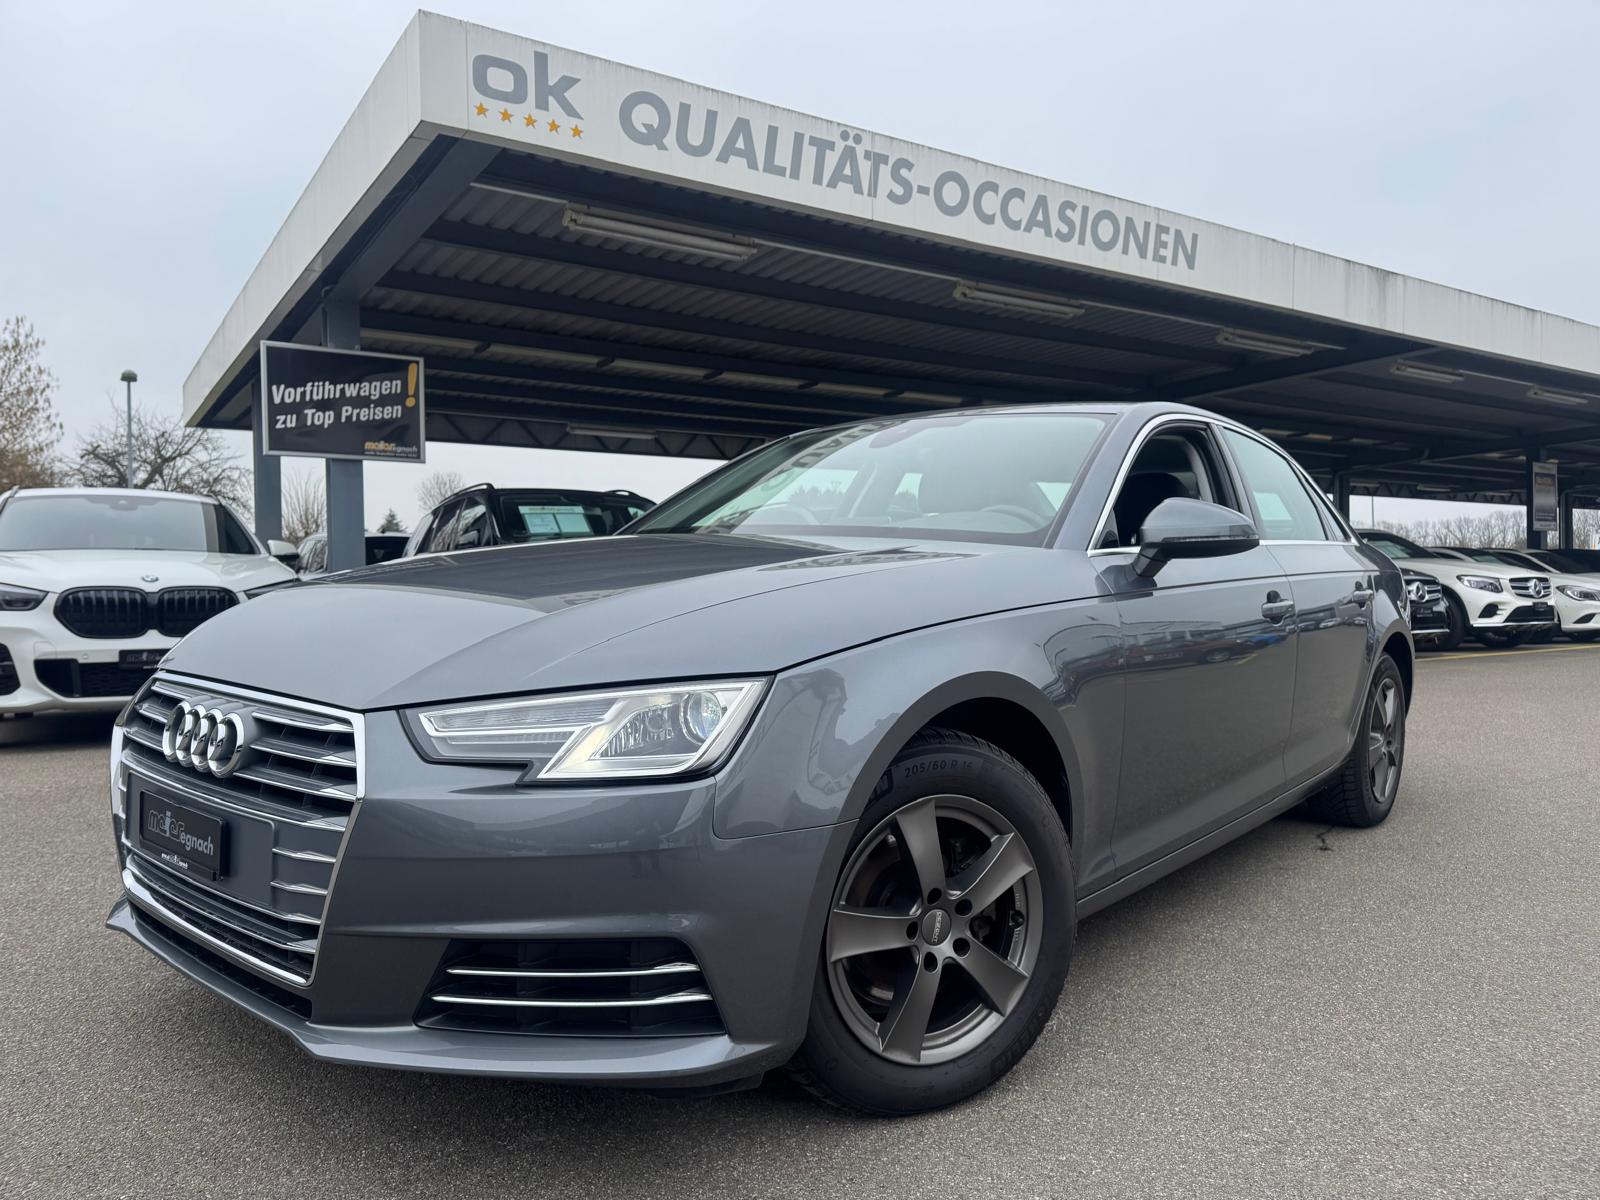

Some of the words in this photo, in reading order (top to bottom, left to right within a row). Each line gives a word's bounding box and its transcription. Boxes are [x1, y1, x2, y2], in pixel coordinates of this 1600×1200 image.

[472, 51, 584, 121] ok
[618, 90, 1199, 271] QUALITÄTS-OCCASIONEN
[271, 379, 402, 405] Vorführwagen
[275, 413, 297, 429] zu
[304, 408, 335, 429] Top
[341, 404, 402, 423] Preisen
[904, 761, 946, 779] 205/60
